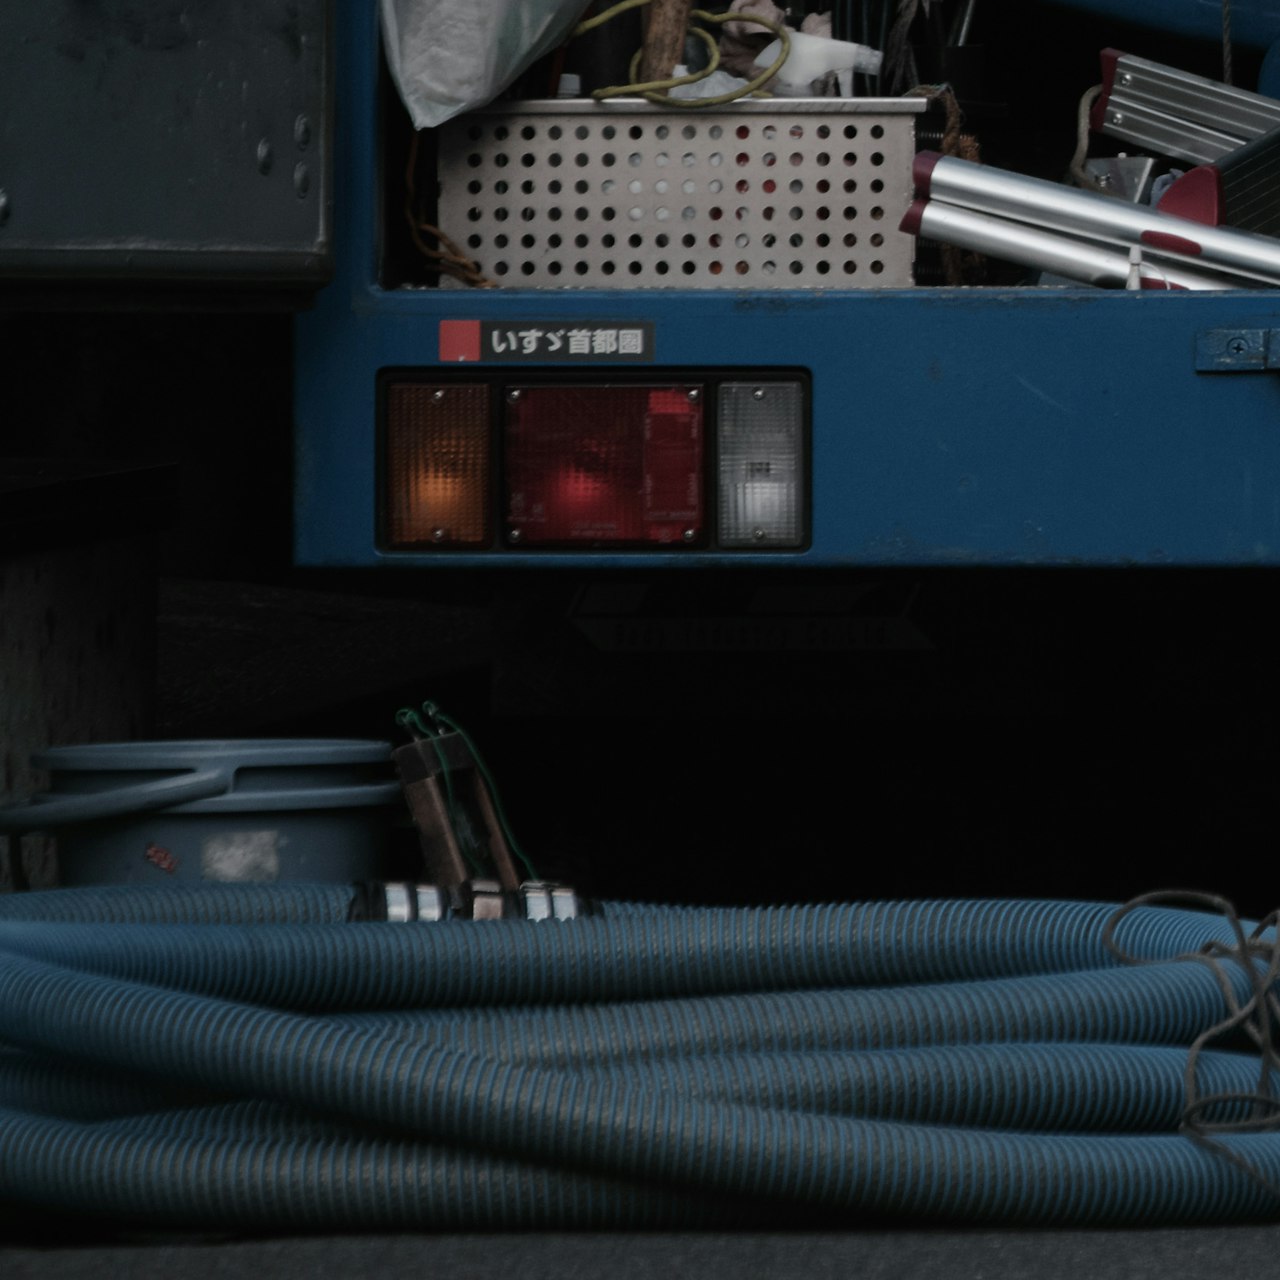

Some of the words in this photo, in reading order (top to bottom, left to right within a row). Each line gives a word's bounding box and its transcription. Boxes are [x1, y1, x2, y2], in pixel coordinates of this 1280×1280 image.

[491, 328, 644, 354] いすゞ首都圏
